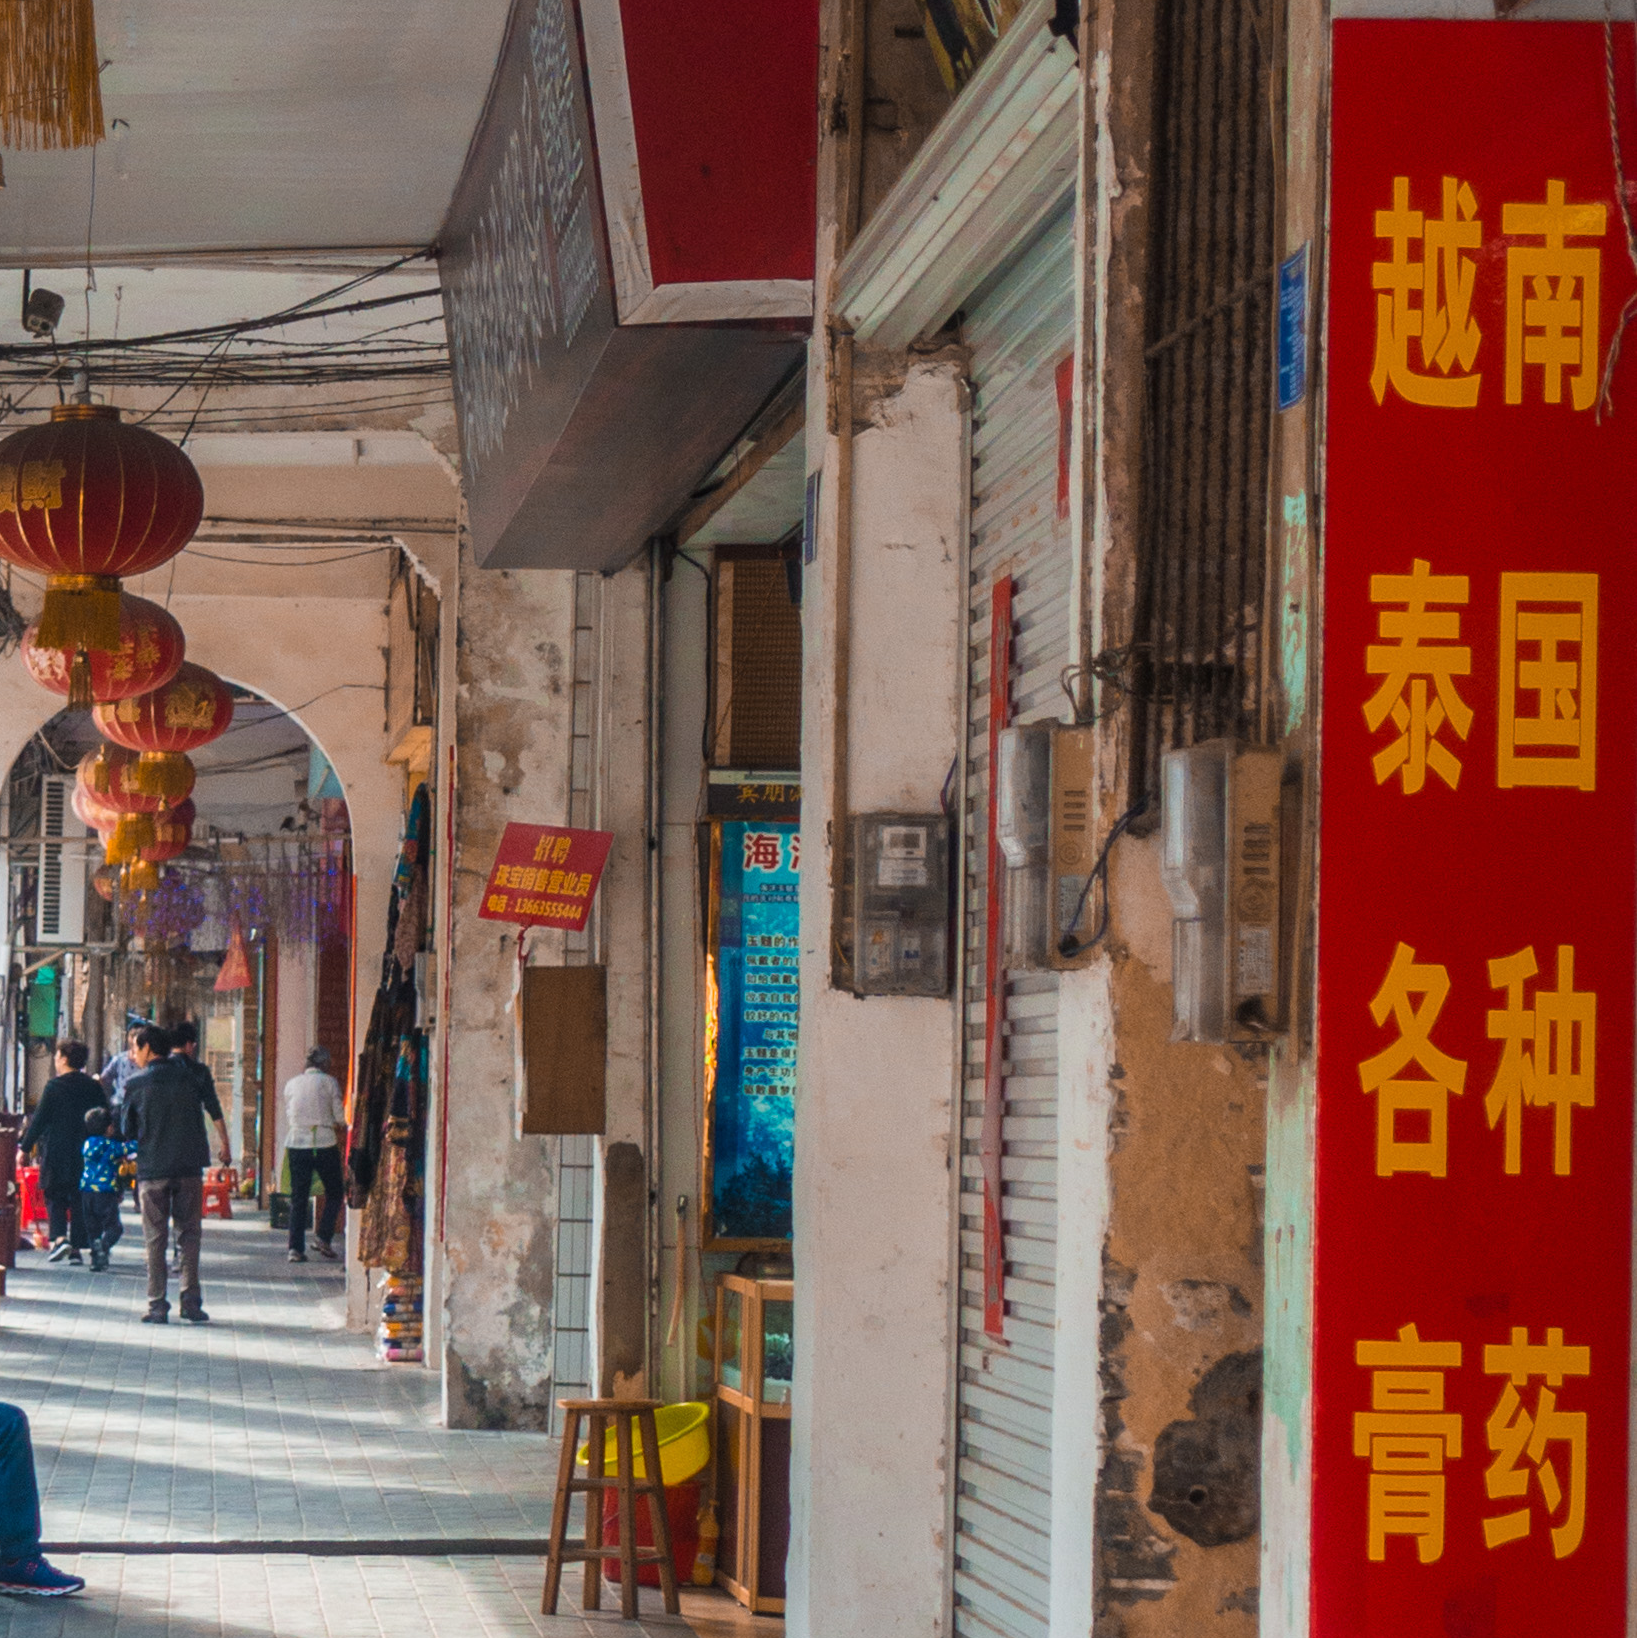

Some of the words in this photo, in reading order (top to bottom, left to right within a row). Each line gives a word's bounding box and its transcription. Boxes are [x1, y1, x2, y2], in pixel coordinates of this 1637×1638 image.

[1369, 175, 1607, 411] 越南
[1362, 560, 1601, 793] 泰国
[494, 864, 593, 898] 珠宝销售营业员
[533, 834, 572, 864] 招聘
[1358, 941, 1599, 1178] 各种
[1352, 1322, 1591, 1566] 膏药
